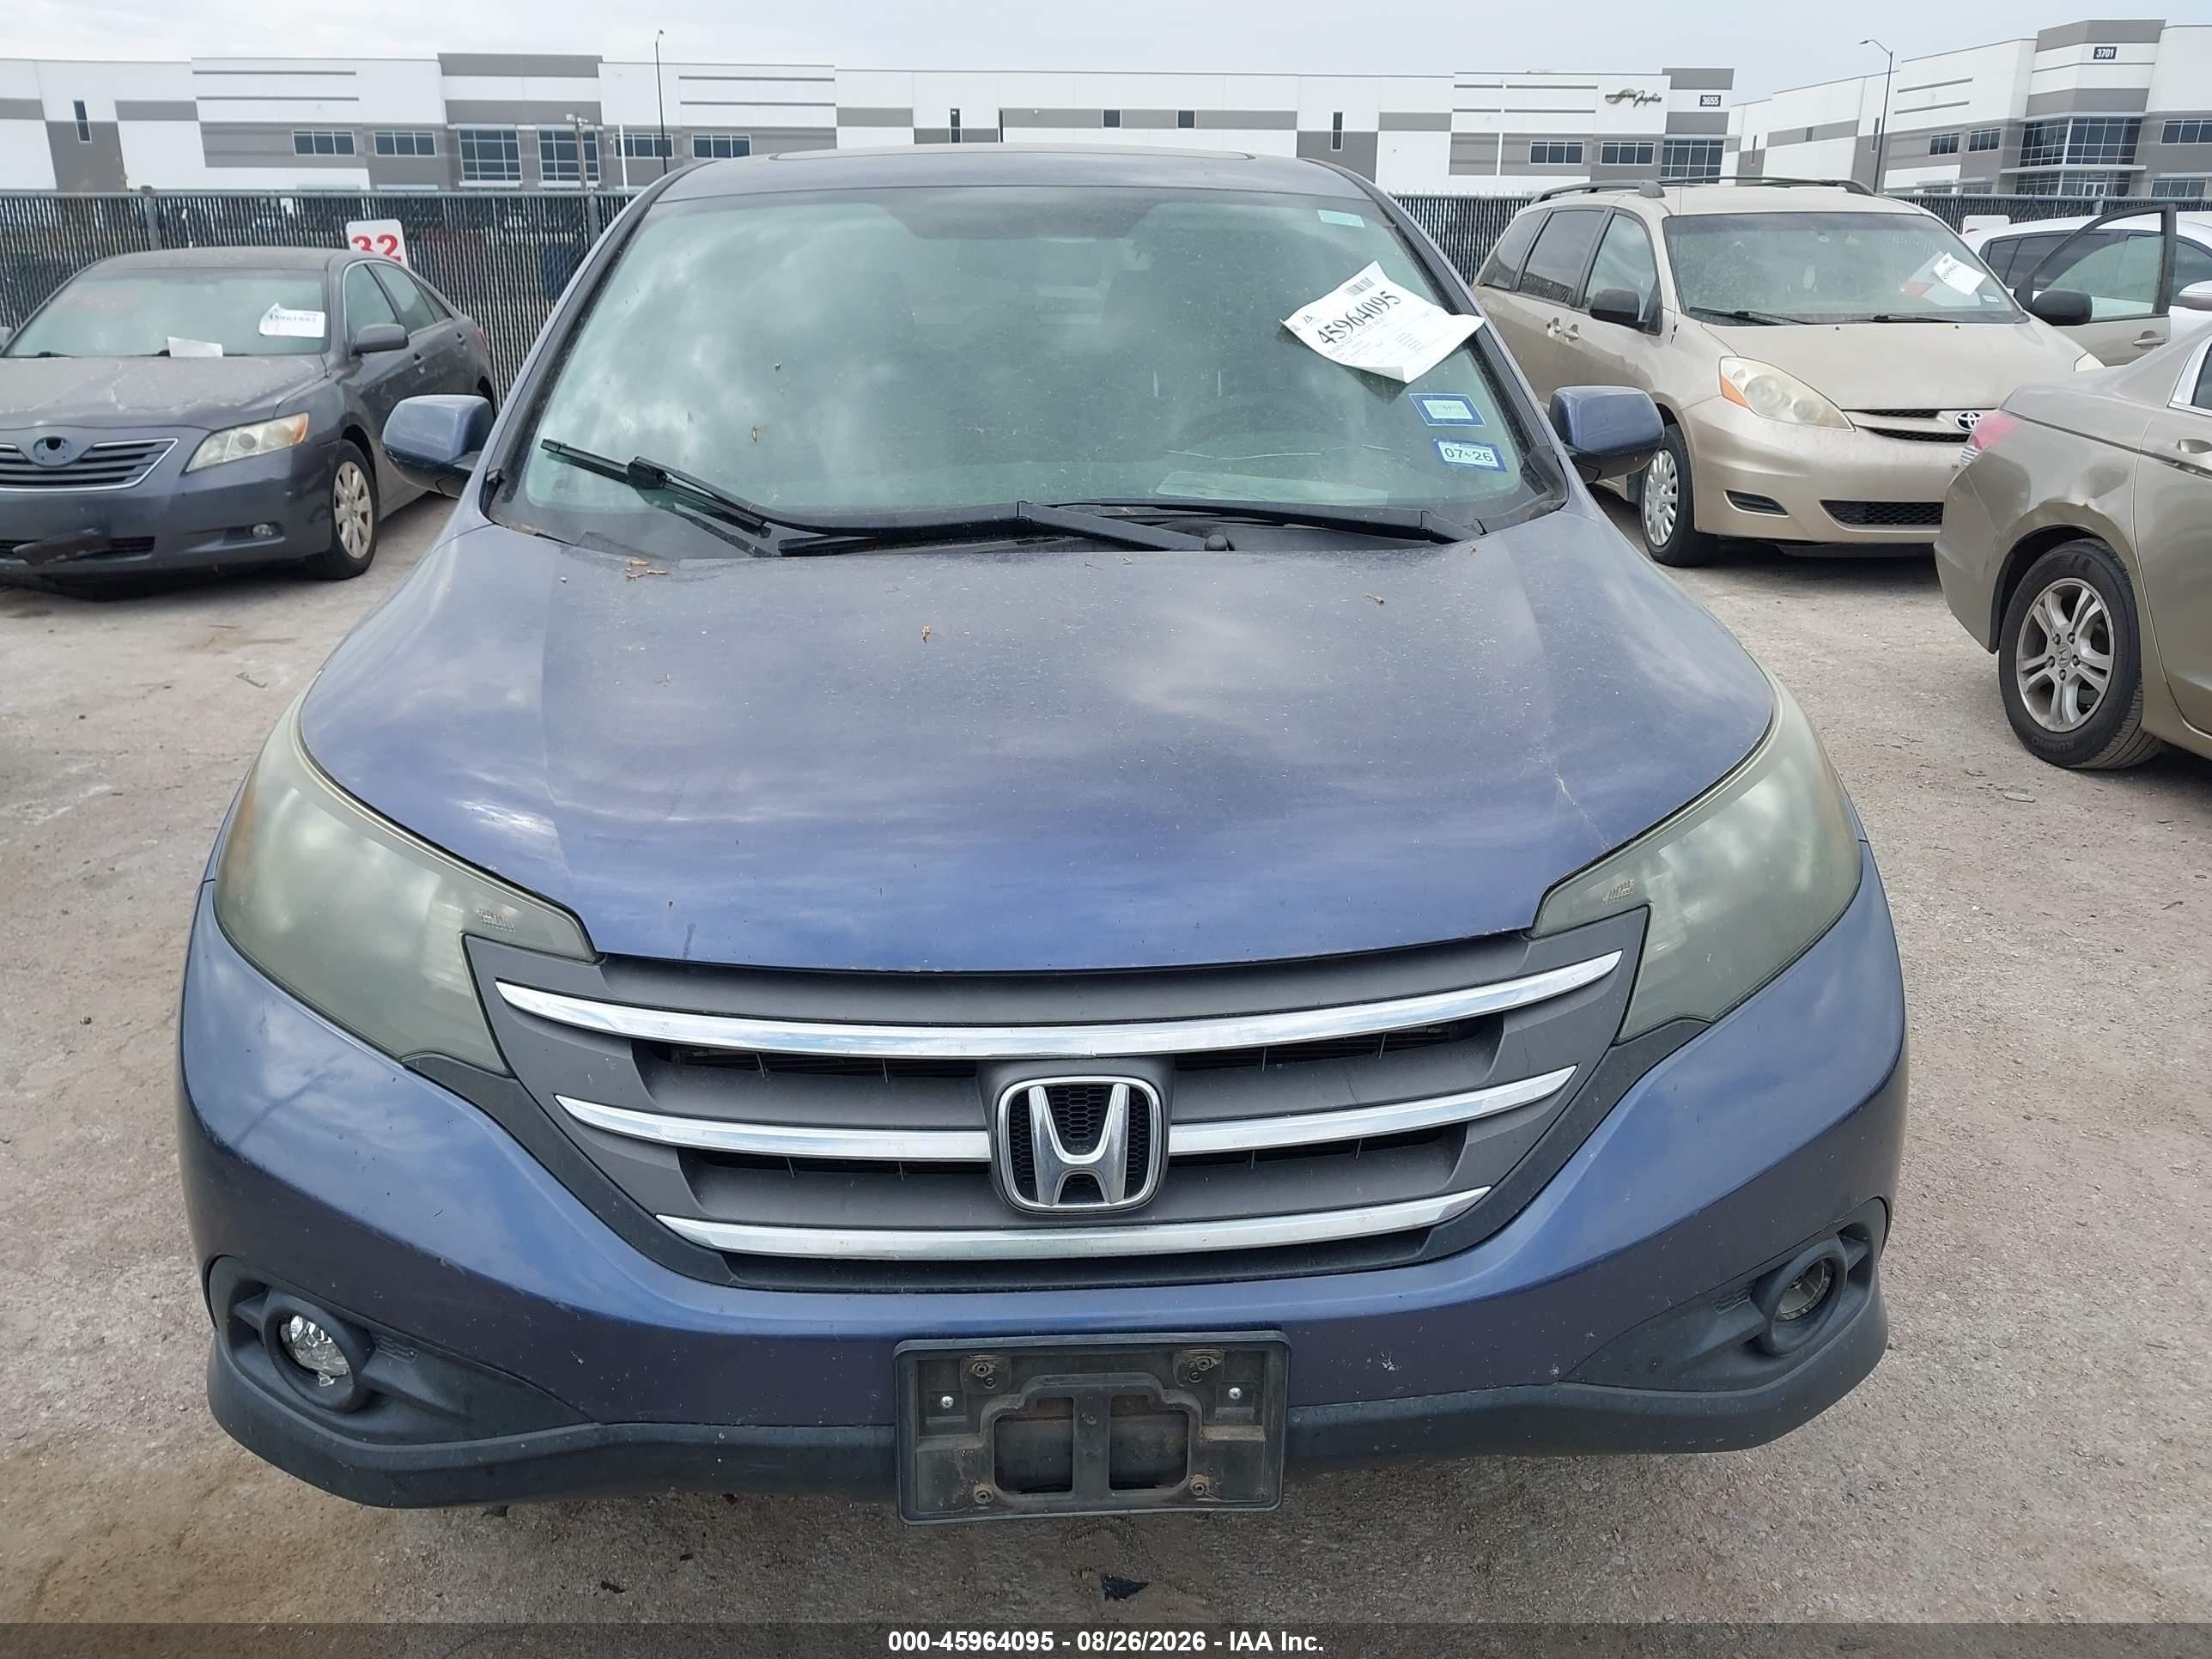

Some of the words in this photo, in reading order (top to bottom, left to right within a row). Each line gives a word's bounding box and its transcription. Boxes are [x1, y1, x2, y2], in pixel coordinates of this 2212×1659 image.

[2096, 48, 2115, 58] 3701
[1701, 95, 1719, 105] 3655
[351, 234, 402, 261] 32
[1316, 291, 1401, 344] 45964095
